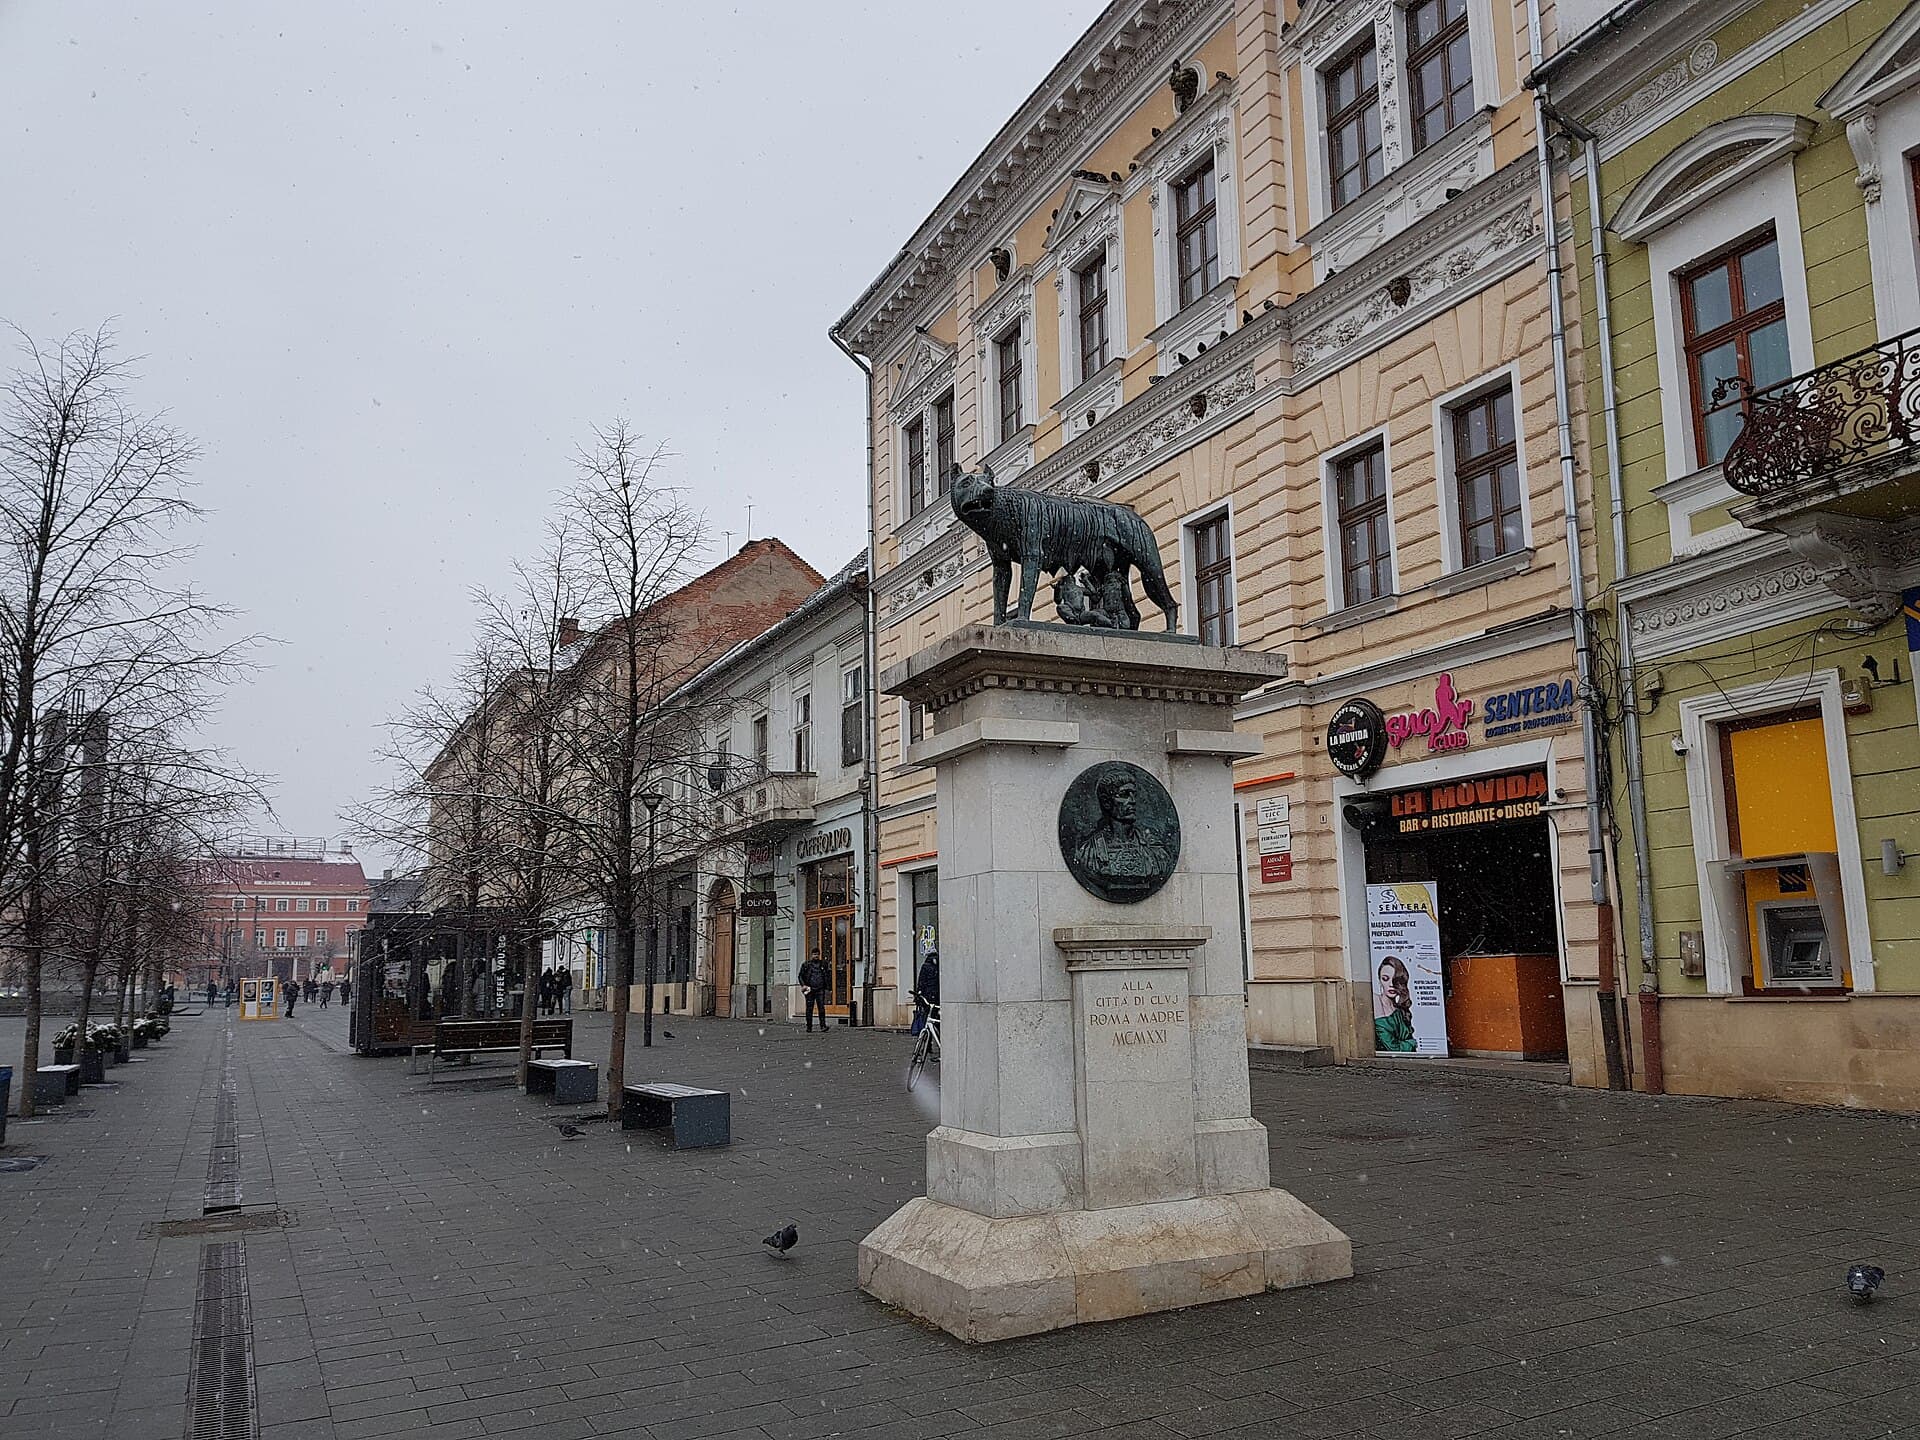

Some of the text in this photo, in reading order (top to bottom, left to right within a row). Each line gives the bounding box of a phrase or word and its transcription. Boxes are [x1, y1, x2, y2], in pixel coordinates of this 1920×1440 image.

[1484, 679, 1573, 724] SENTERA
[1329, 729, 1369, 746] LA MOVIDA
[1434, 731, 1469, 751] CLUB
[1333, 751, 1369, 771] COCKTAIL BAR
[1391, 771, 1548, 817] LA MOVIDA
[1400, 801, 1541, 833] BAR RISTORANTE DISCO
[746, 899, 772, 907] OLIVO
[1379, 902, 1428, 911] SENTERA
[1121, 981, 1153, 991] ALLA
[1134, 996, 1145, 1006] DI
[1090, 1010, 1185, 1026] ROMA MADRE
[1112, 1029, 1168, 1047] MCMXXI
